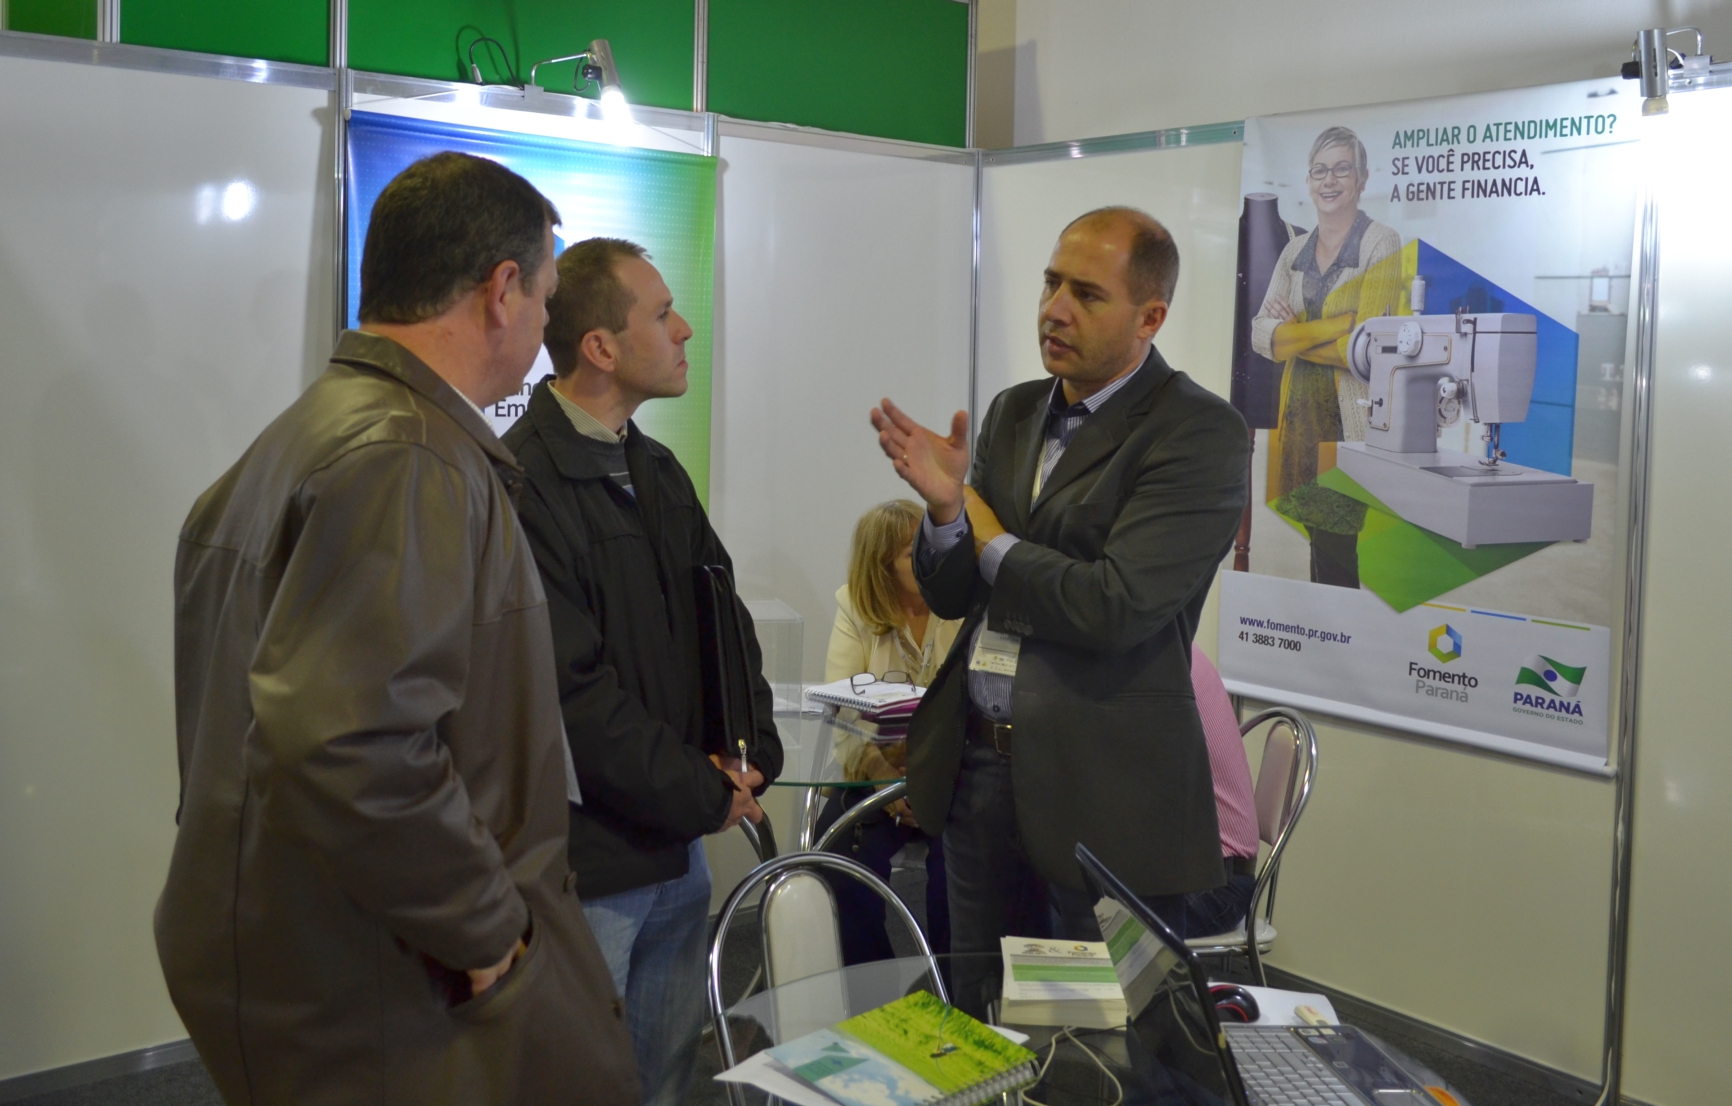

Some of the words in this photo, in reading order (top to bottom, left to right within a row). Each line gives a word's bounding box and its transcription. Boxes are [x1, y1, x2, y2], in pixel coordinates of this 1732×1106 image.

[1391, 126, 1461, 149] AMPLIAR
[1466, 124, 1477, 144] O
[1481, 113, 1617, 143] ATENDIMENTO?
[1391, 156, 1410, 176] SE
[1414, 148, 1455, 175] VOCÊ
[1460, 148, 1535, 172] PRECISA,
[1390, 183, 1401, 203] A
[1406, 180, 1456, 202] GENTE
[1461, 176, 1546, 199] FINANCIA.
[494, 398, 526, 417] Em
[1238, 630, 1249, 642] 41
[1252, 633, 1275, 647] 3883
[1277, 637, 1302, 652] 7000
[1239, 615, 1352, 645] www.fomento.pr.gov.br
[1408, 661, 1479, 689] Fomento
[1415, 678, 1469, 703] Paraná
[1512, 706, 1544, 718] GOVERNO
[1556, 715, 1584, 726] ESTADO
[1513, 691, 1584, 717] PARANÁ
